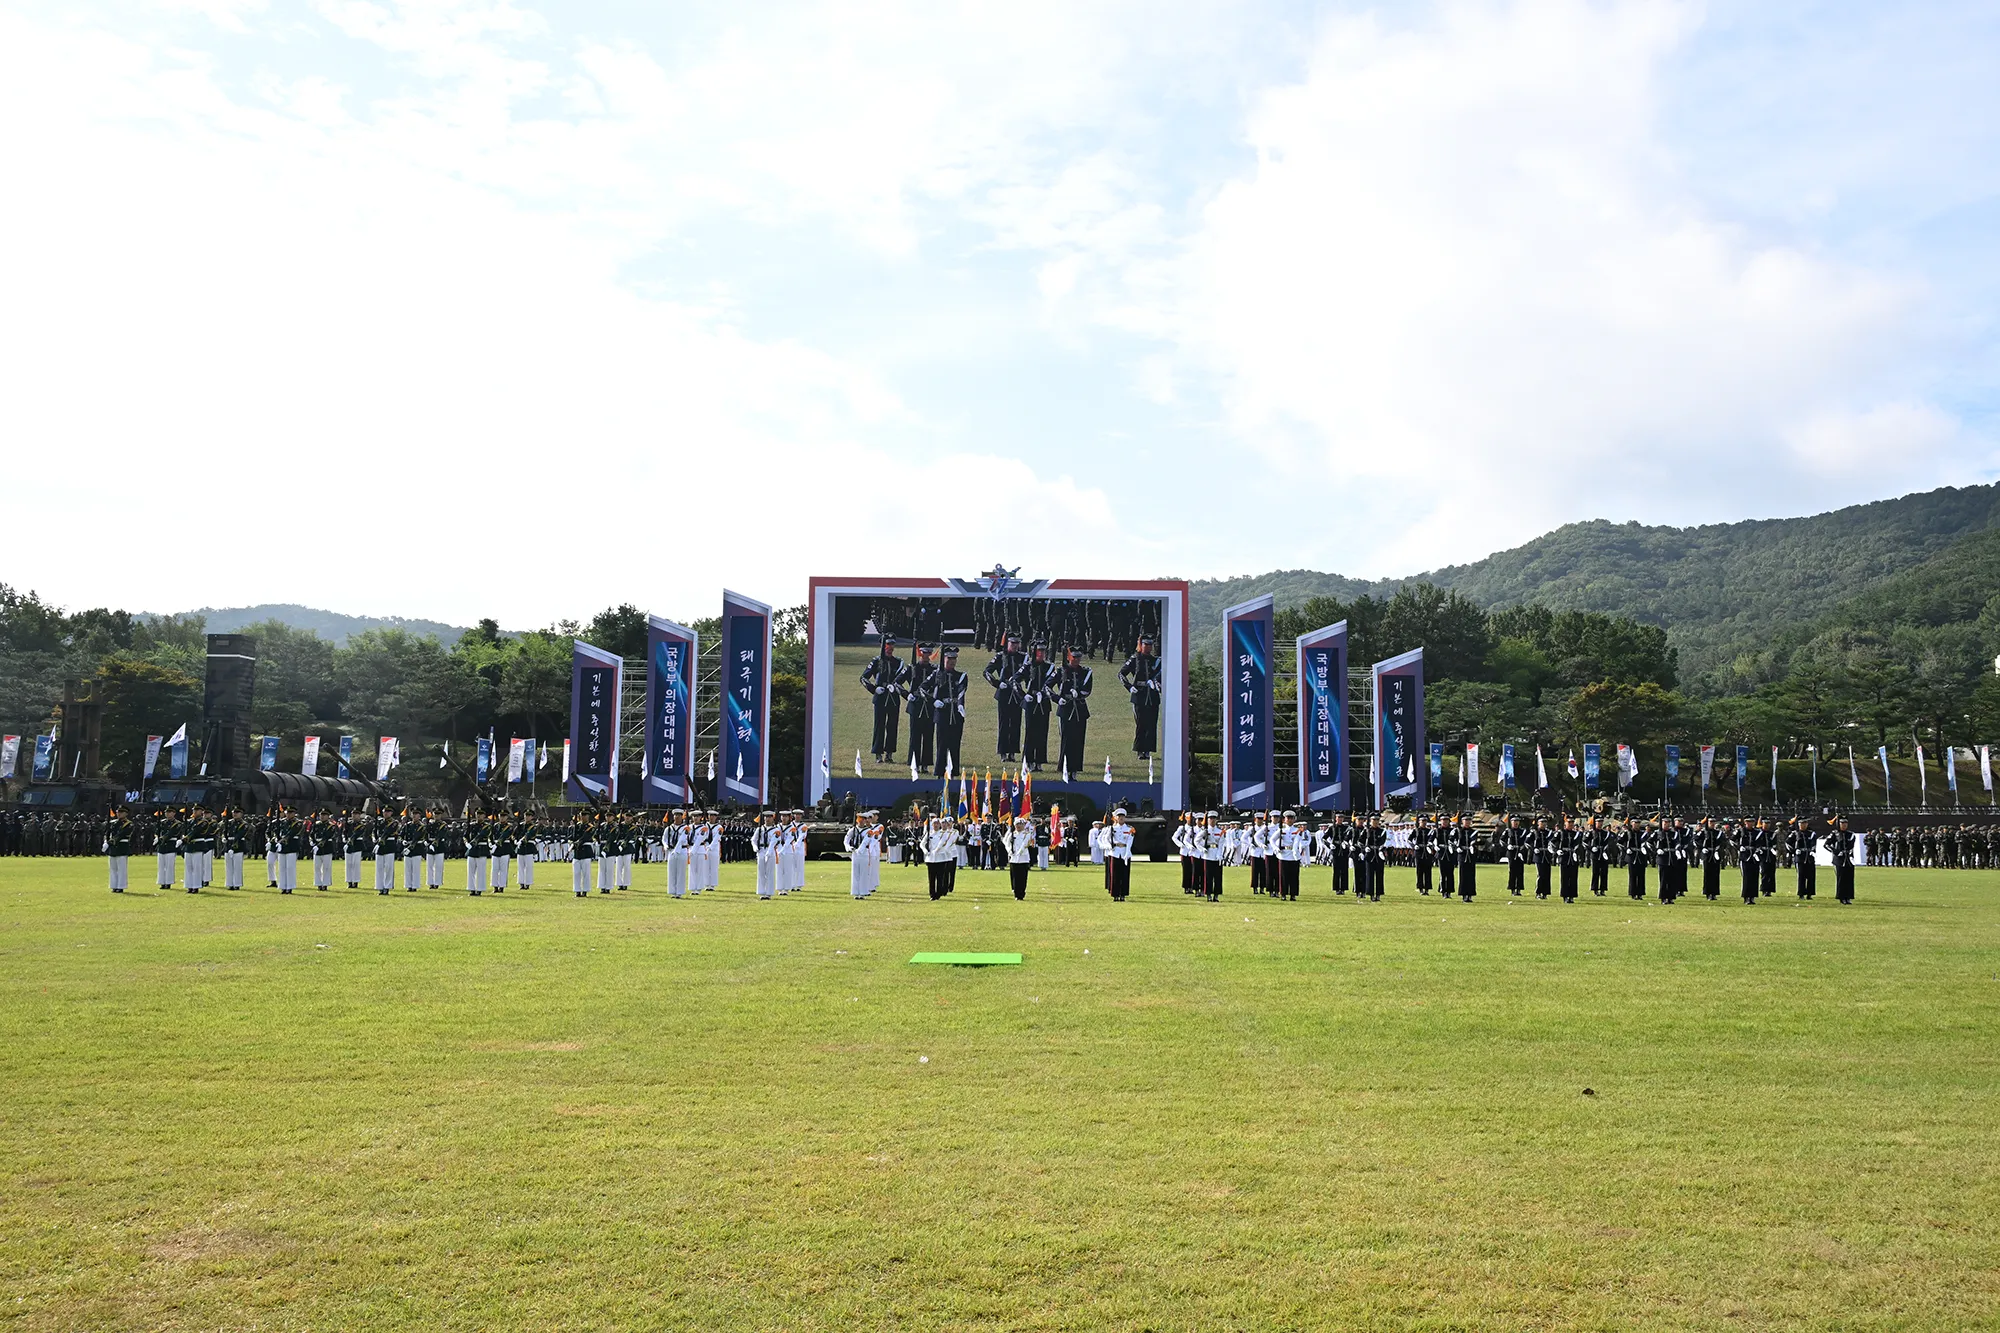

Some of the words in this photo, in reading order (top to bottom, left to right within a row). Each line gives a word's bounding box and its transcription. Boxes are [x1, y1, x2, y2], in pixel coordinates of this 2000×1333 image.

[666, 647, 678, 683] 국방부
[739, 650, 754, 702] 태극기
[1239, 654, 1254, 706] 태극기
[1316, 653, 1328, 690] 국방부
[590, 672, 602, 708] 기본에
[1393, 680, 1403, 716] 기본에
[664, 689, 677, 740] 의장대대
[738, 709, 752, 742] 대형
[1239, 714, 1254, 746] 대형
[1317, 695, 1329, 746] 의장대대
[663, 743, 674, 769] 시범
[1318, 750, 1330, 776] 시범
